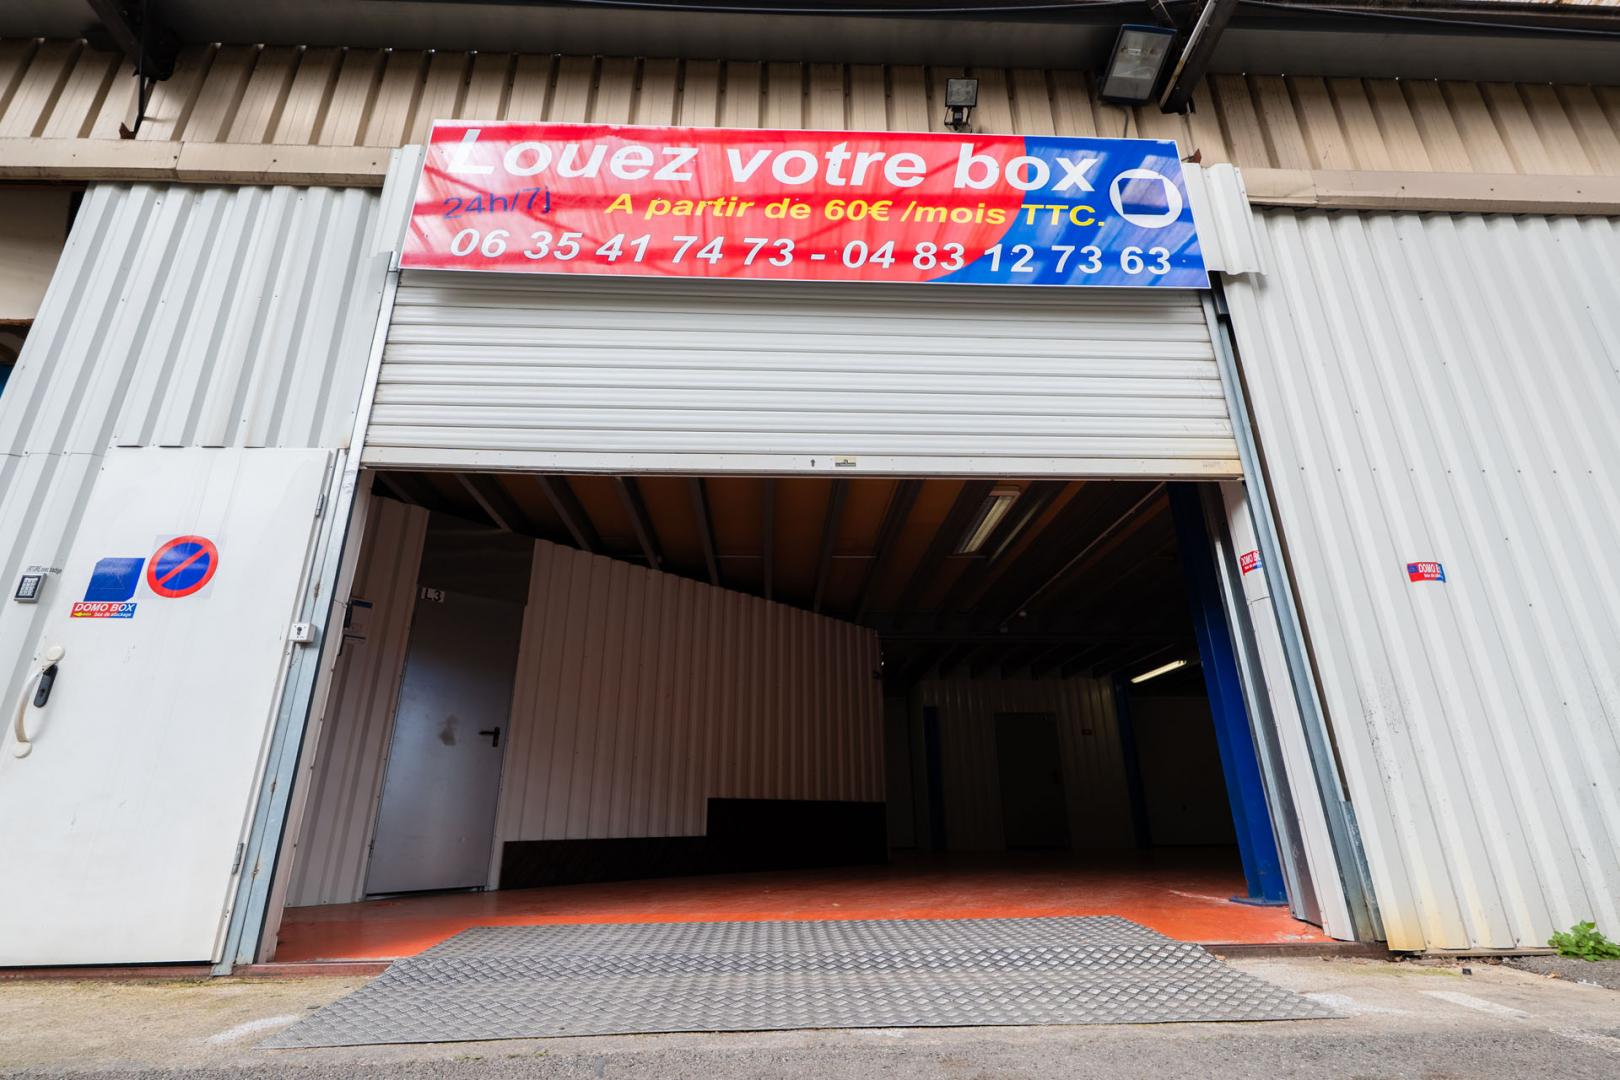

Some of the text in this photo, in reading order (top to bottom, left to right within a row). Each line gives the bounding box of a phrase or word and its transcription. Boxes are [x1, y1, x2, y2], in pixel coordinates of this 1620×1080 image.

[448, 128, 1099, 192] Louez votre box
[443, 187, 551, 220] 24h/7j
[604, 193, 1104, 227] A partir de 60€ /mois TTC.
[450, 228, 510, 258] 06
[523, 230, 583, 261] 35
[595, 233, 652, 263] 41
[671, 235, 725, 265] 74
[743, 237, 795, 268] 73
[842, 240, 896, 269] 04
[912, 241, 965, 271] 83
[984, 243, 1034, 273] 12
[1051, 244, 1103, 274] 73
[1120, 246, 1172, 275] 63
[74, 603, 135, 612] DOMO BOX
[424, 588, 441, 602] L3
